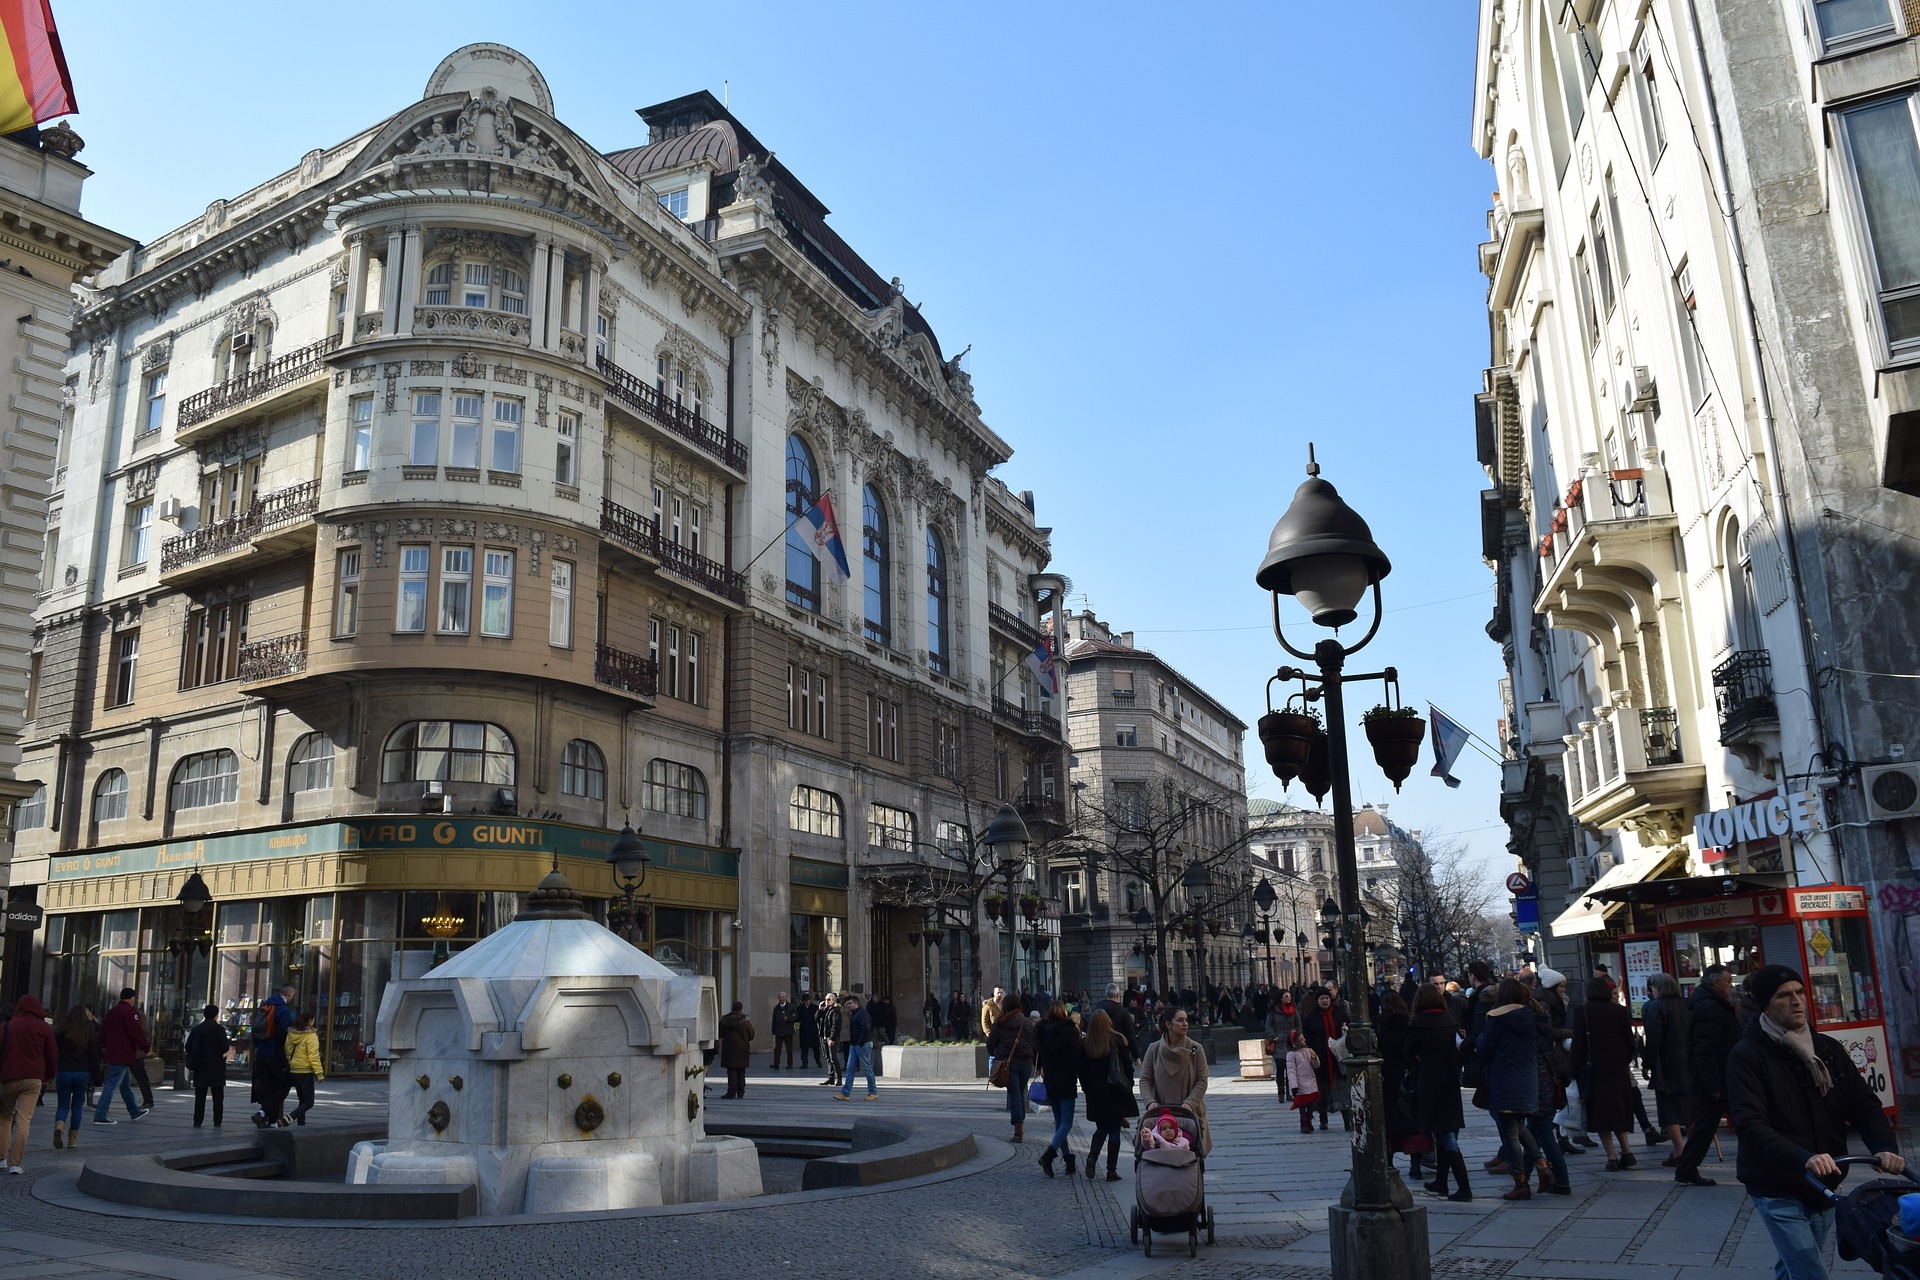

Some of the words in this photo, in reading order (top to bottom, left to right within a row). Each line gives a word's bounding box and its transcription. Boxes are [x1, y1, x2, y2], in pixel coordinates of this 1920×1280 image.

[1694, 791, 1812, 849] KOKICE
[344, 825, 416, 844] EVRO
[472, 825, 543, 845] GIUNTI
[55, 860, 79, 873] EVRO
[95, 855, 121, 869] GIUNTI
[8, 912, 38, 922] adidas
